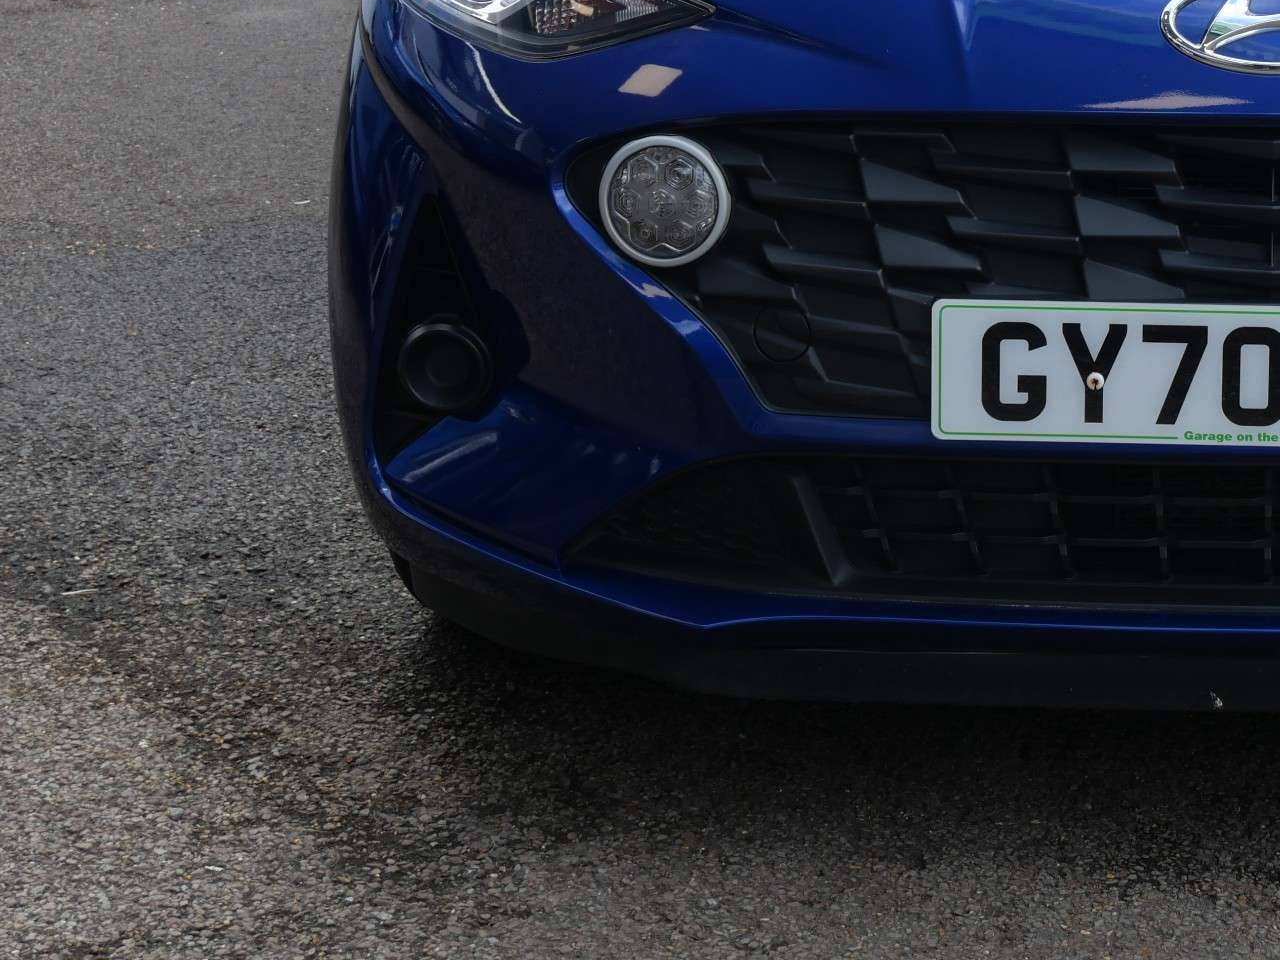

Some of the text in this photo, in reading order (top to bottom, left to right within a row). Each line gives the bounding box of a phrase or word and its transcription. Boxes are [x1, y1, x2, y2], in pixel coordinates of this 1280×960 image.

[1184, 430, 1233, 443] Garage
[1236, 433, 1253, 442] on
[1257, 432, 1279, 442] the
